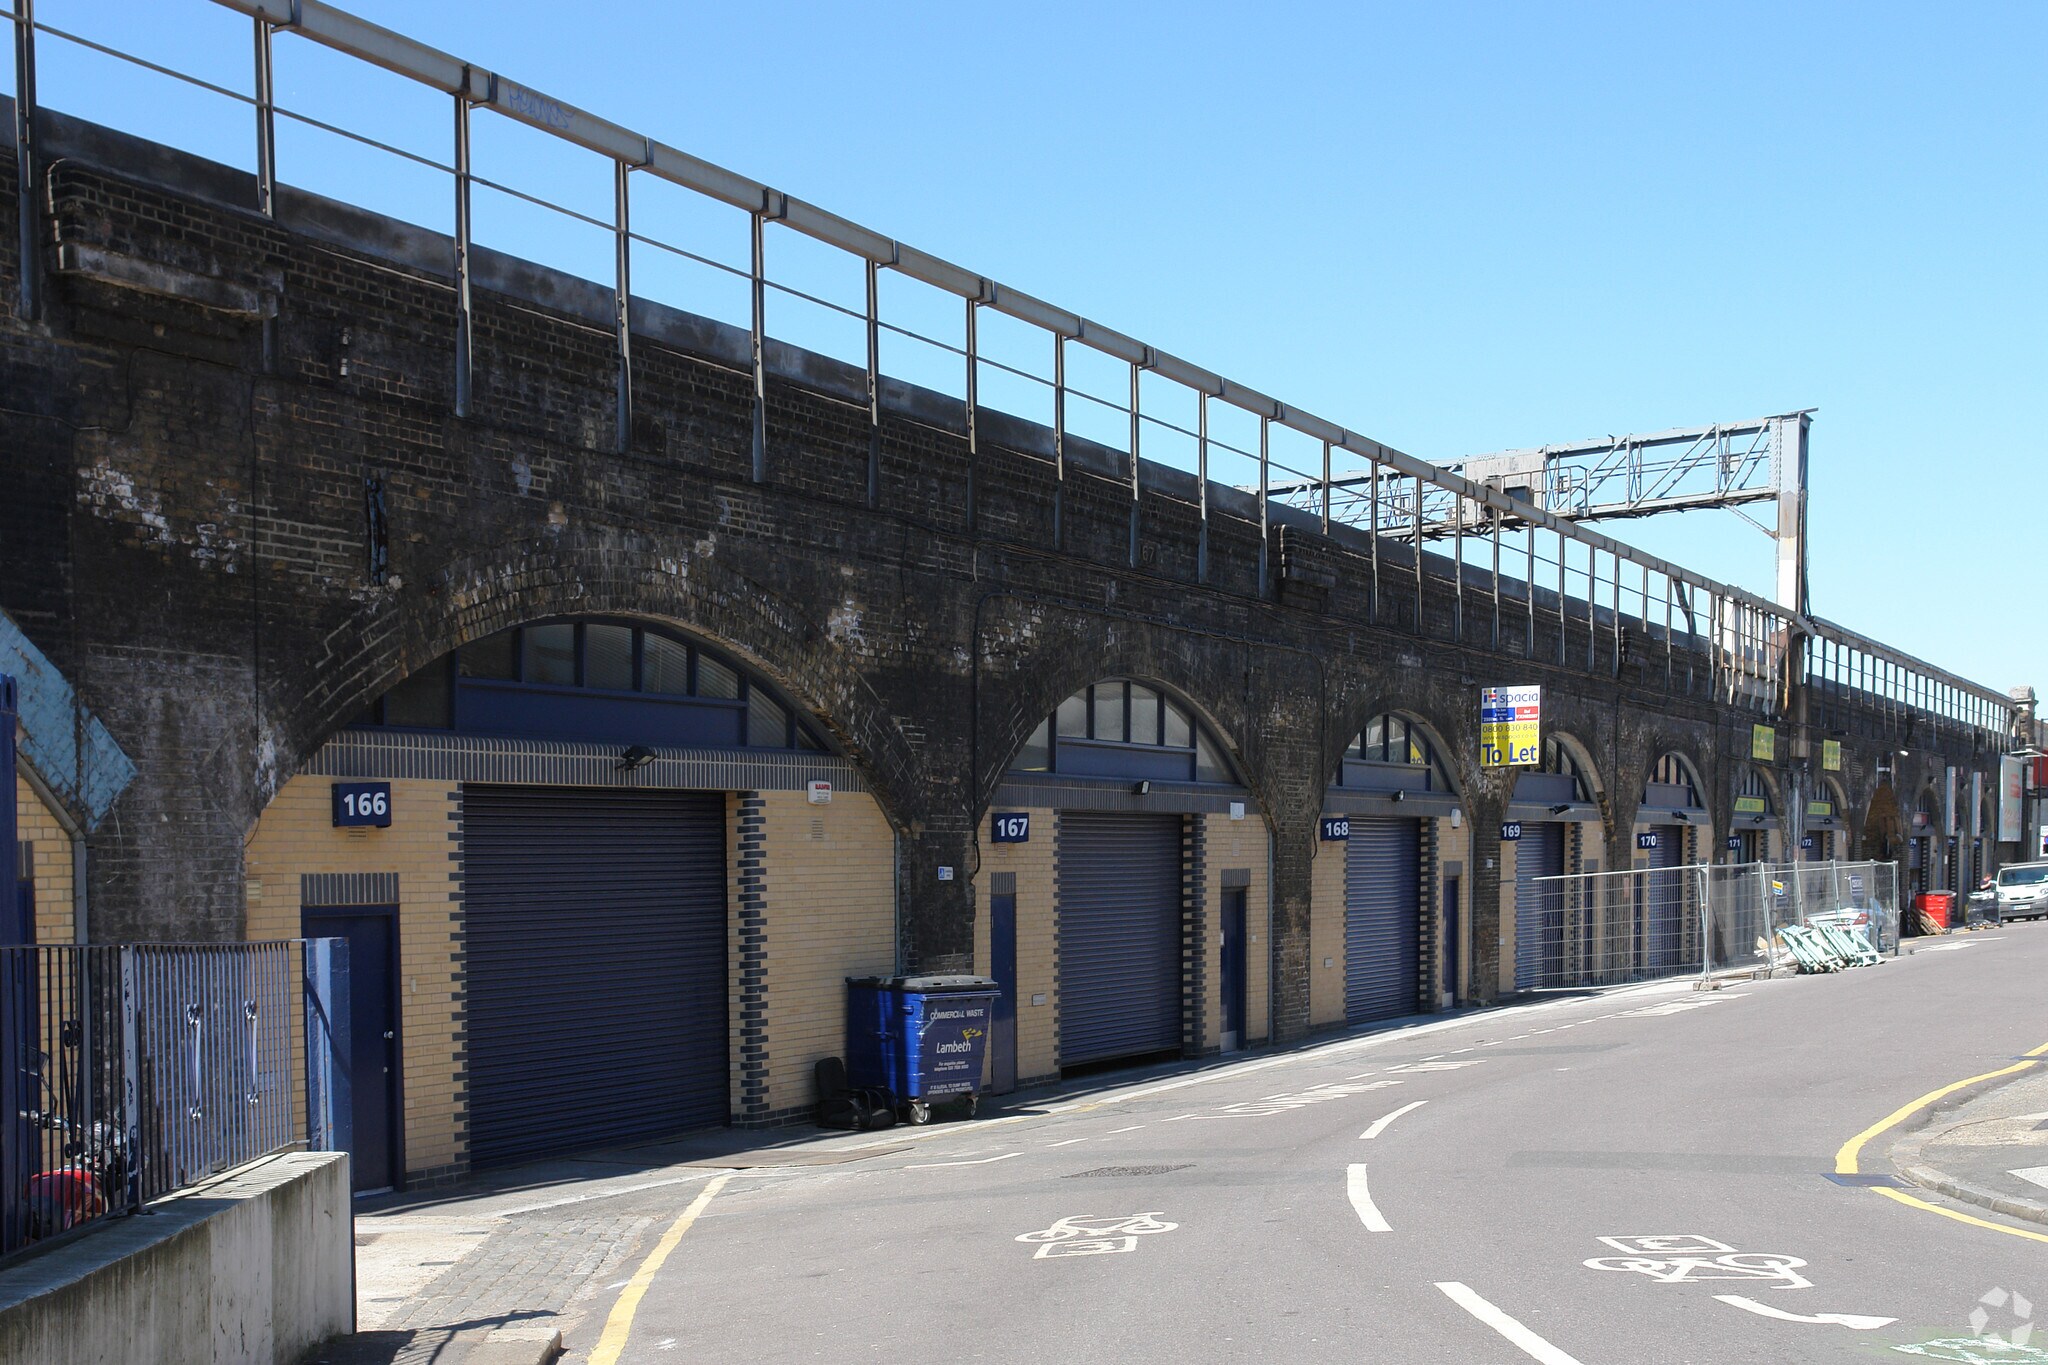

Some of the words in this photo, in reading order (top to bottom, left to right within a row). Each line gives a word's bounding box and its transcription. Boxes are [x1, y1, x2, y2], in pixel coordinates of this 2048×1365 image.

[1499, 691, 1539, 706] spacia
[1482, 725, 1503, 733] 0800
[1505, 723, 1521, 732] 830
[1522, 723, 1538, 731] 840
[1482, 743, 1503, 763] To
[1509, 742, 1537, 762] Let
[343, 792, 387, 816] 166
[997, 818, 1028, 837] 167
[1325, 821, 1349, 836] 168
[1502, 825, 1520, 837] 169
[1640, 835, 1657, 846] 170
[1728, 838, 1741, 848] 171
[966, 1008, 984, 1018] WASTE
[936, 1040, 972, 1053] Lambeth
